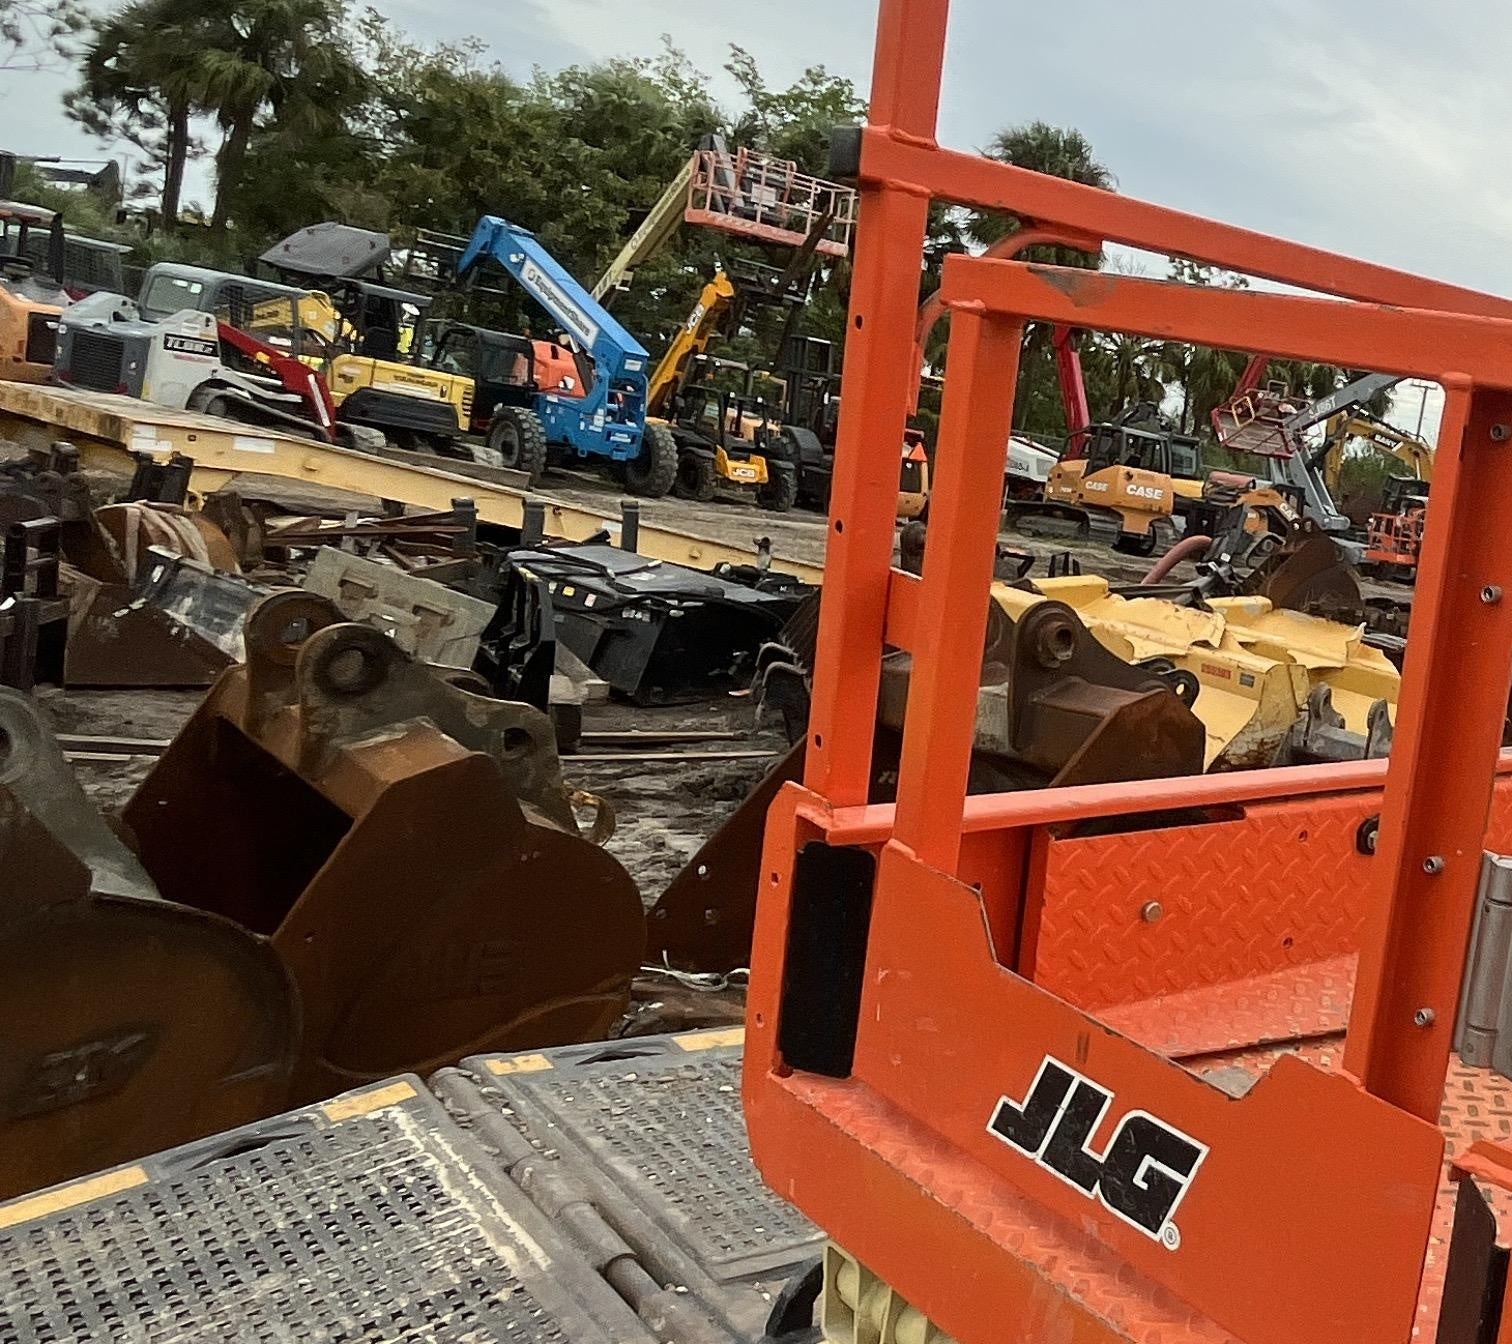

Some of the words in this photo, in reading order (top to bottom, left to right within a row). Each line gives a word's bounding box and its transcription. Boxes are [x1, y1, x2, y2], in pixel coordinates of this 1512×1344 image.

[732, 467, 755, 478] JCB
[1085, 480, 1110, 493] CASE
[1125, 483, 1164, 500] CASE
[987, 1054, 1210, 1242] JLG
